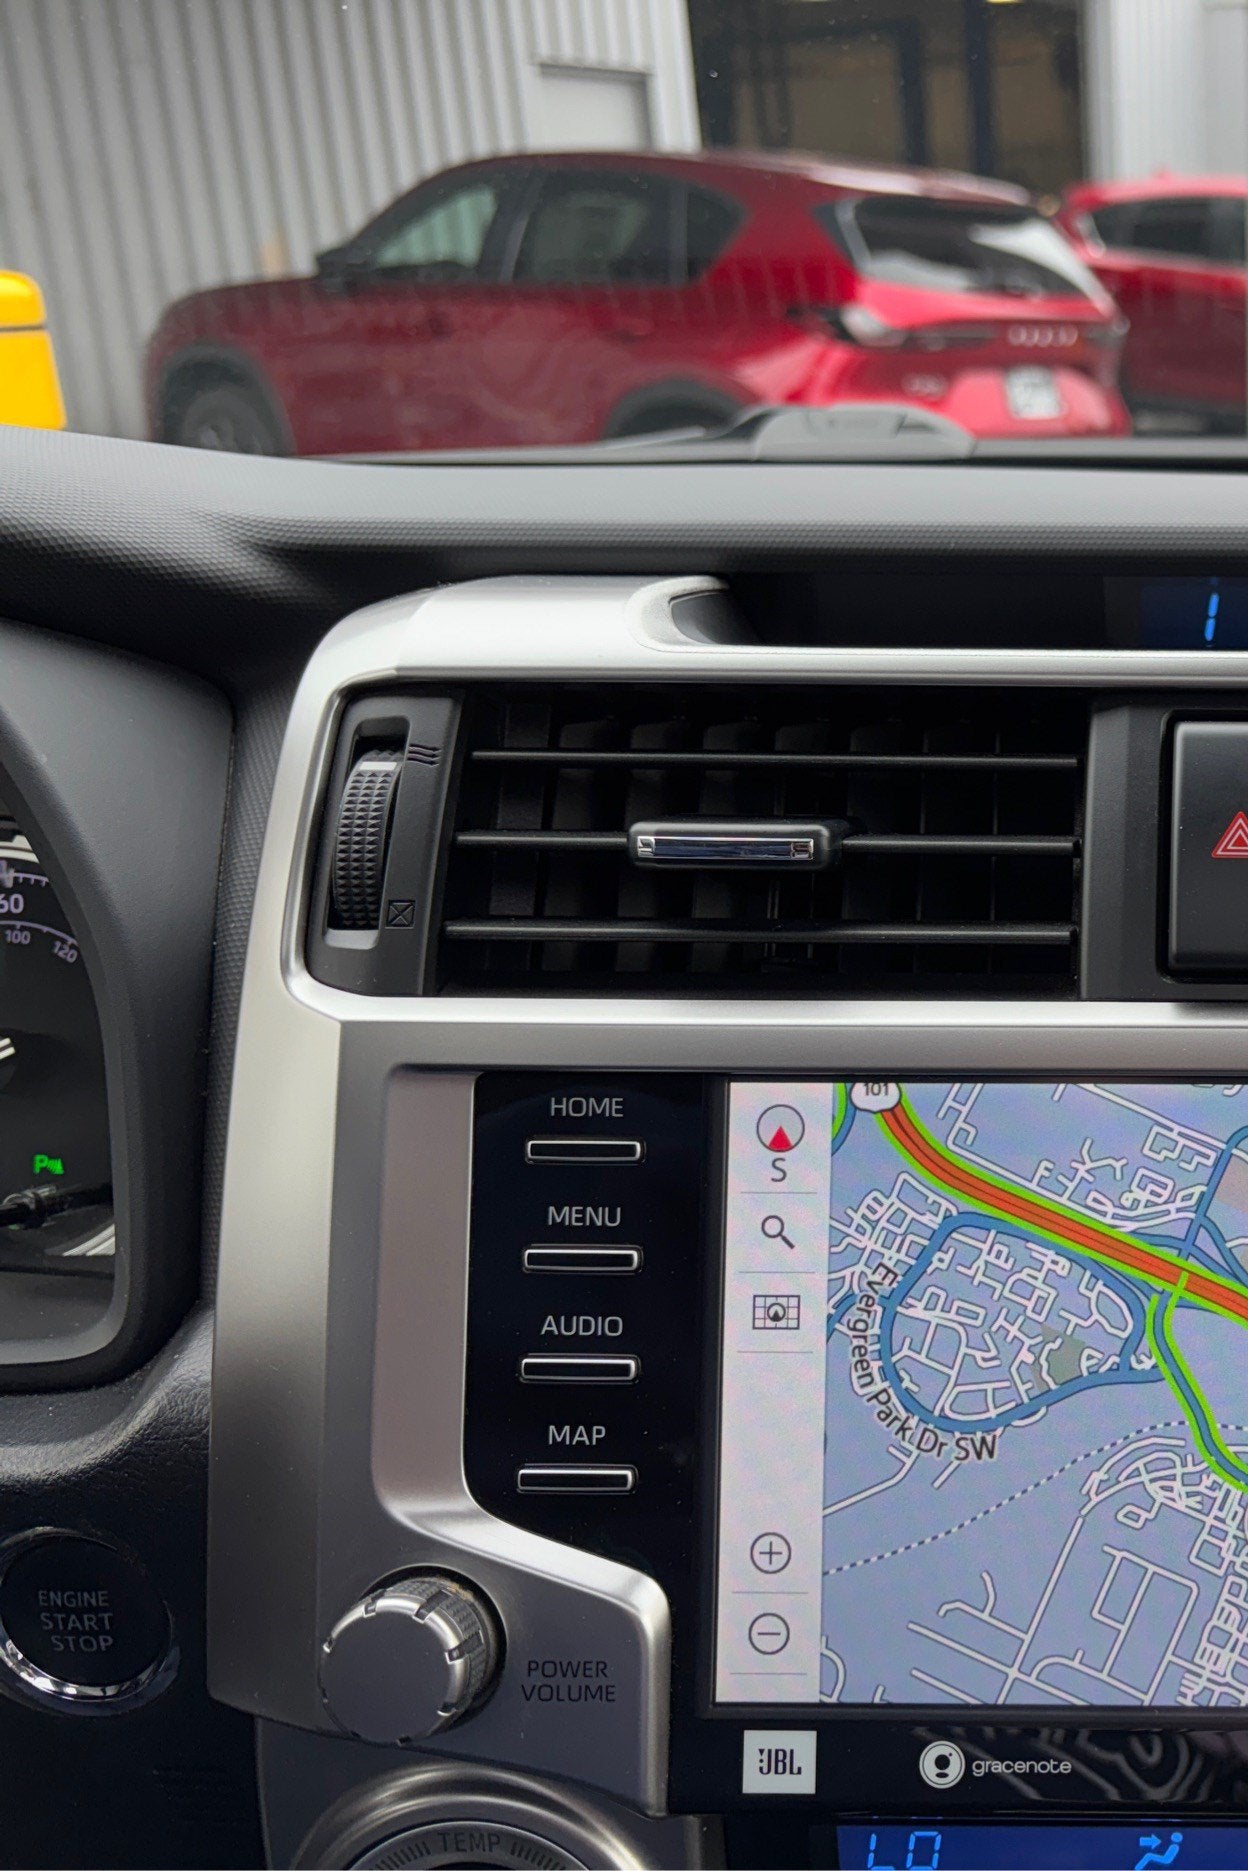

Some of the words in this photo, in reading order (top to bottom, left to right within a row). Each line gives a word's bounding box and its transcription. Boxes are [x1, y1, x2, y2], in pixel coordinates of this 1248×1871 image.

[5, 929, 31, 945] 100
[53, 940, 78, 963] 120
[863, 1083, 889, 1096] 101
[550, 1097, 624, 1118] HOME
[771, 1157, 787, 1183] S
[547, 1206, 621, 1227] MENU
[540, 1315, 624, 1337] AUDIO
[847, 1262, 899, 1389] Evergreen
[866, 1387, 916, 1443] Park
[548, 1425, 606, 1446] MAP
[916, 1427, 949, 1458] Dr
[954, 1434, 997, 1461] SW
[37, 1590, 110, 1608] ENGINE
[40, 1612, 114, 1631] START
[50, 1635, 114, 1652] STOP
[527, 1660, 608, 1678] POWER
[521, 1684, 616, 1702] VOLUME
[759, 1748, 802, 1776] JBL
[972, 1759, 1072, 1777] gracenote
[437, 1831, 500, 1853] TEMP
